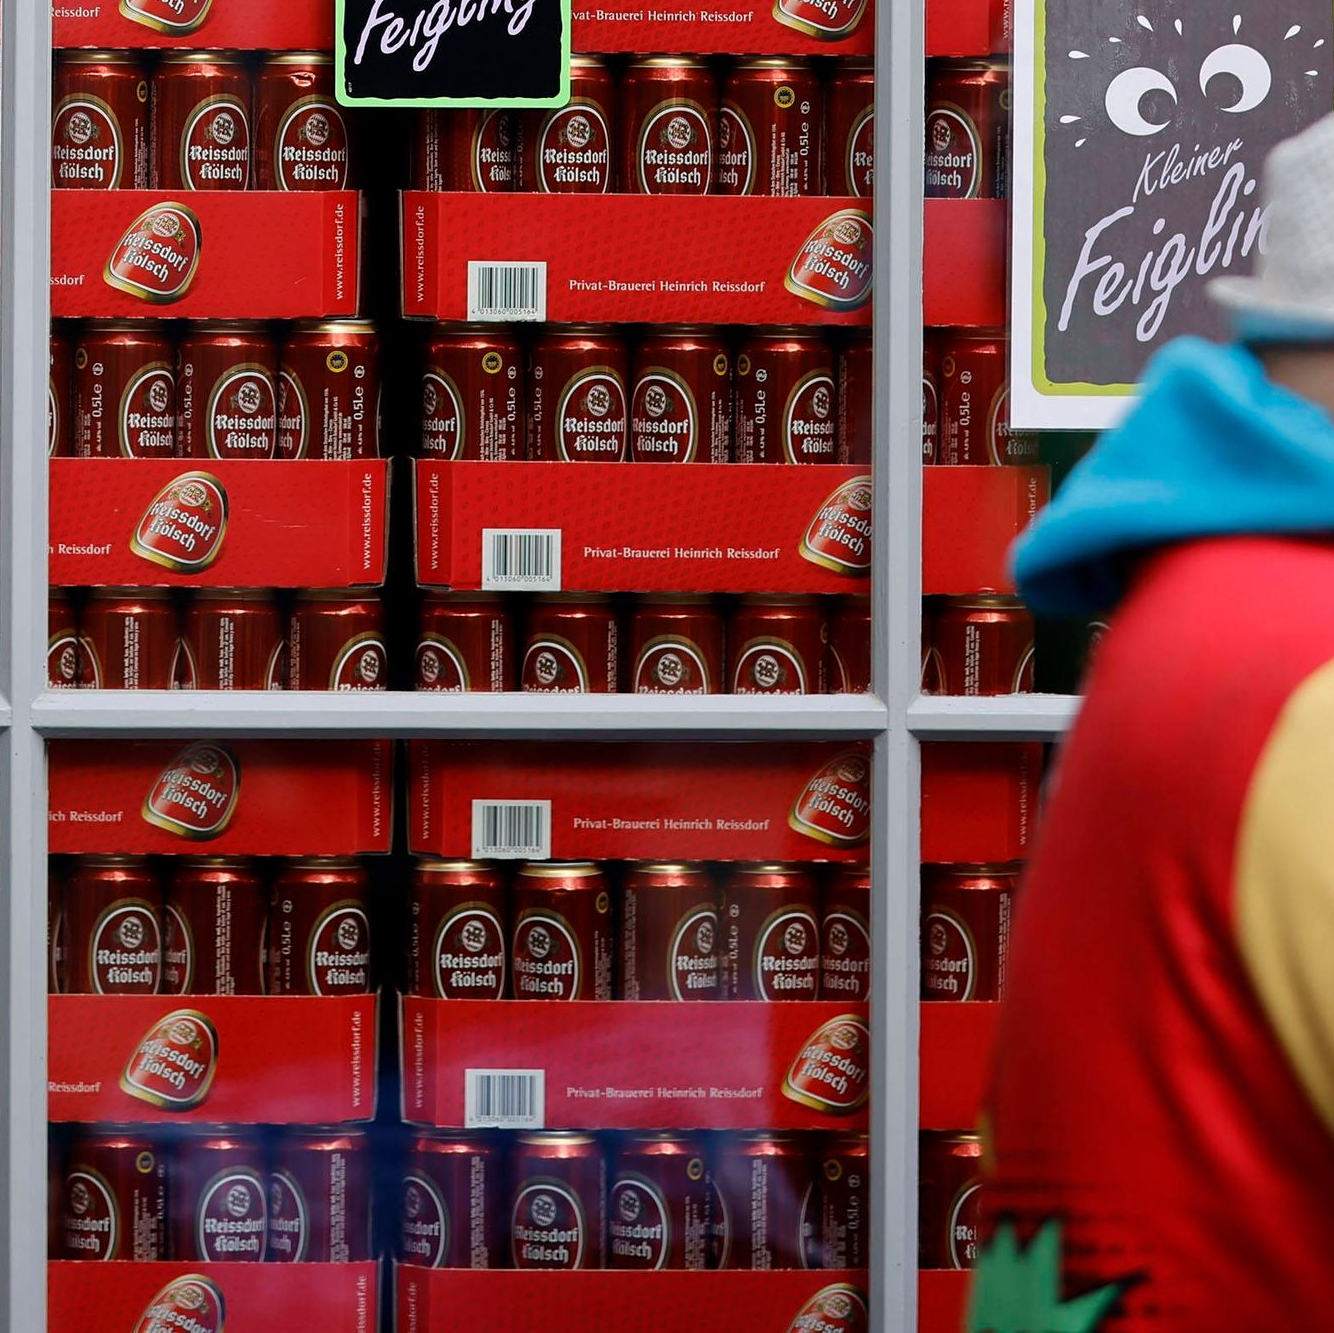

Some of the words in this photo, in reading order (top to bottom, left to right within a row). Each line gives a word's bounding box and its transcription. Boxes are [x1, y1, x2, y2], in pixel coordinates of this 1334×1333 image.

[648, 10, 696, 23] Heinrich
[700, 10, 753, 23] Reissdorf
[281, 145, 346, 163] Reissdorf
[543, 148, 607, 165] Reissdorf
[644, 148, 709, 165] Reissdorf
[292, 163, 339, 183] Kölsch
[554, 166, 601, 185] Kölsch
[654, 166, 702, 186] Kölsch
[1132, 137, 1243, 203] Kleiner
[123, 233, 188, 270] Reissdorf
[334, 204, 344, 300] www.reissdorf.de
[415, 206, 424, 302] www.reissdorf.de
[804, 242, 871, 279] Reissdorf
[1058, 162, 1270, 341] Feiglin
[122, 249, 169, 281] Kölsch
[803, 258, 850, 290] Kölsch
[570, 280, 655, 293] Privat-Brauerei
[660, 280, 708, 293] Heinrich
[712, 280, 765, 293] Reissdorf
[151, 503, 215, 539] Reissdorf
[363, 473, 372, 569] www.reissdorf.de
[430, 473, 439, 569] www.reissdorf.de
[150, 518, 195, 551] Kölsch
[59, 542, 111, 555] Reissdorf
[584, 547, 670, 560] Privat-Brauerei
[675, 547, 722, 560] Heinrich
[727, 547, 780, 560] Reissdorf
[162, 770, 227, 806] Reissdorf
[161, 786, 208, 818] Kölsch
[70, 810, 123, 823] Reissdorf
[574, 818, 660, 831] Privat-Brauerei
[664, 818, 712, 831] Heinrich
[716, 818, 770, 831] Reissdorf
[440, 953, 503, 969] Reissdorf
[449, 970, 496, 989] Kölsch
[351, 1010, 361, 1107] www.reissdorf.de
[48, 1081, 101, 1093] Reissdorf
[567, 1086, 654, 1098] Privat-Brauerei
[657, 1086, 705, 1098] Heinrich
[710, 1086, 763, 1098] Reissdorf
